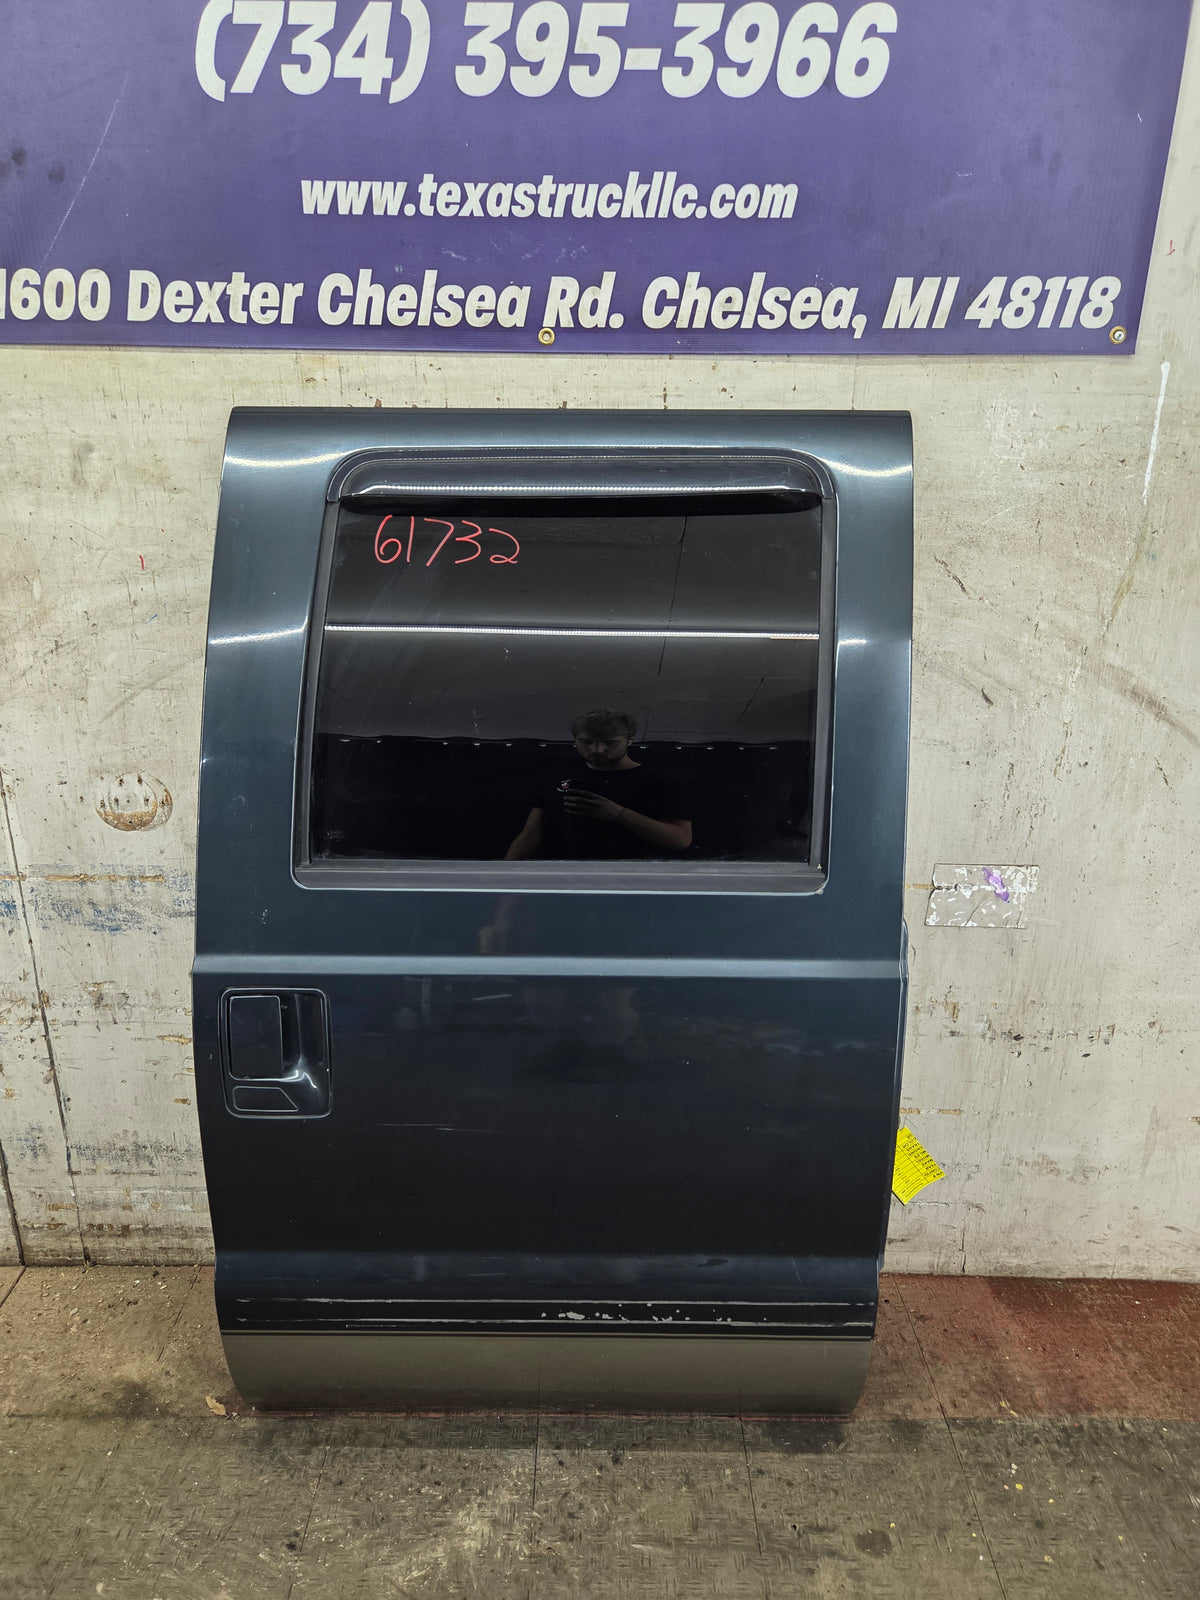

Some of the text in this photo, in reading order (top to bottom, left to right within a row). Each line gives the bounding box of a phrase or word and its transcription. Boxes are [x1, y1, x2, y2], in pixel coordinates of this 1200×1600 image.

[194, 0, 899, 104] (734) 395-3966
[301, 171, 799, 219] www.texastruckllc.com
[127, 270, 305, 325] Dexter
[318, 269, 532, 328] Chelsea
[543, 271, 625, 329] Rd.
[643, 272, 868, 339] Chelsea,
[882, 277, 961, 329] MI
[964, 276, 1122, 330] 48118
[374, 514, 520, 567] 61732
